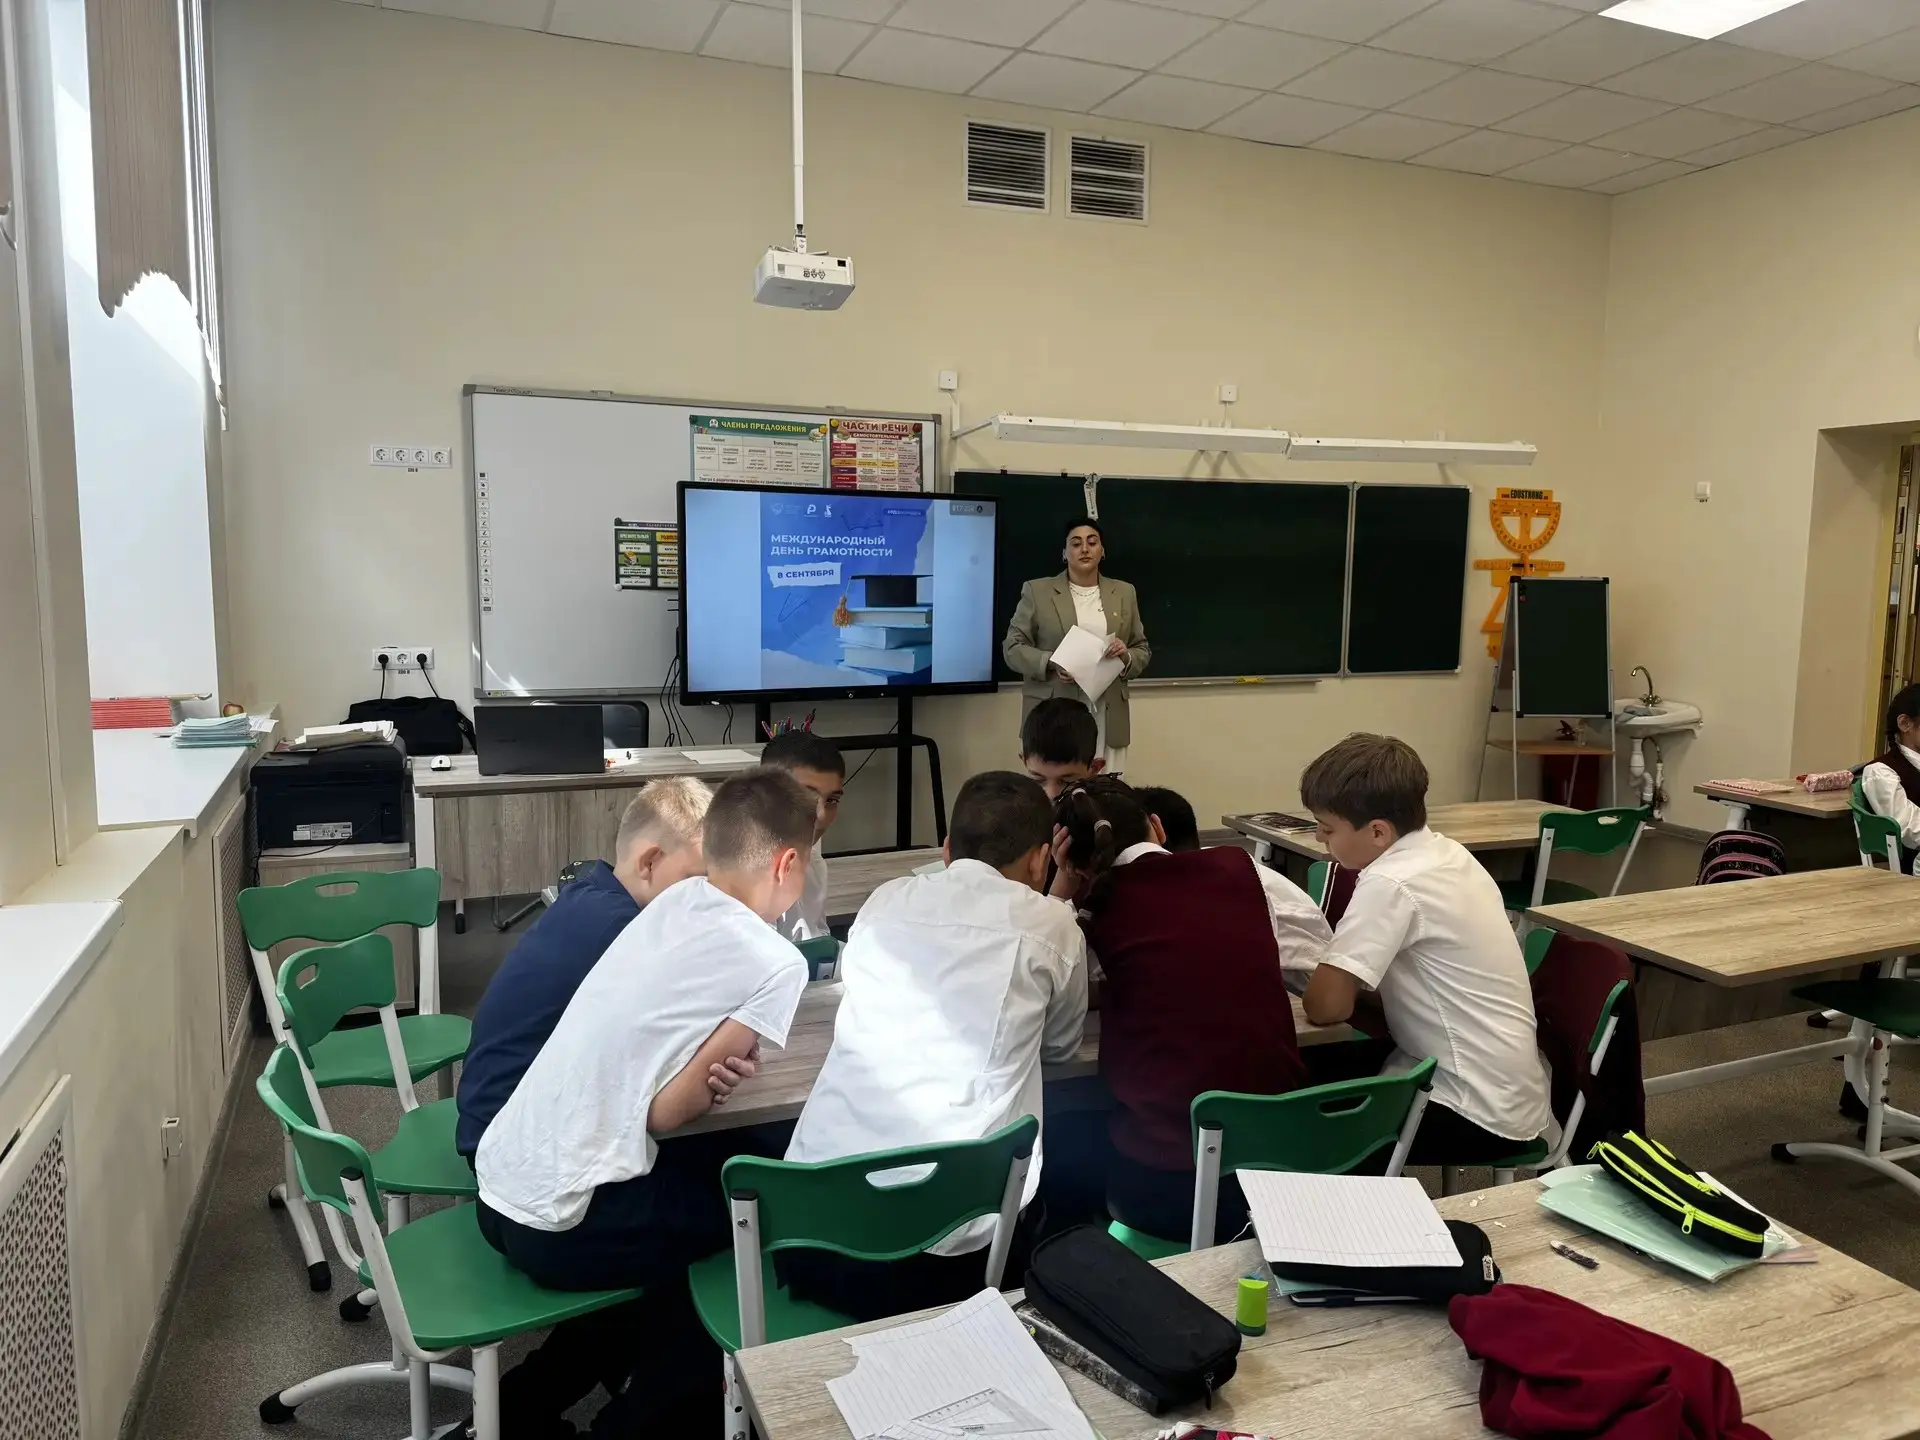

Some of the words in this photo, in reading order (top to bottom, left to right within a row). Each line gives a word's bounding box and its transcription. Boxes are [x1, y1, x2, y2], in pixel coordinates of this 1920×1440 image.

[721, 421, 749, 430] ЧЛЕНЫ
[750, 422, 807, 433] ПРЕДЛОЖЕНИЯ
[843, 422, 878, 431] ЧАСТИ
[881, 423, 908, 432] РЕЧИ
[1510, 490, 1543, 500] EDUSTRONG
[771, 534, 886, 546] МЕЖДУНАРОДНЫЙ
[771, 546, 804, 556] ДЕНЬ
[807, 547, 893, 557] ГРАМОТНОСТИ
[786, 569, 834, 579] СЕНТЯБРЯ
